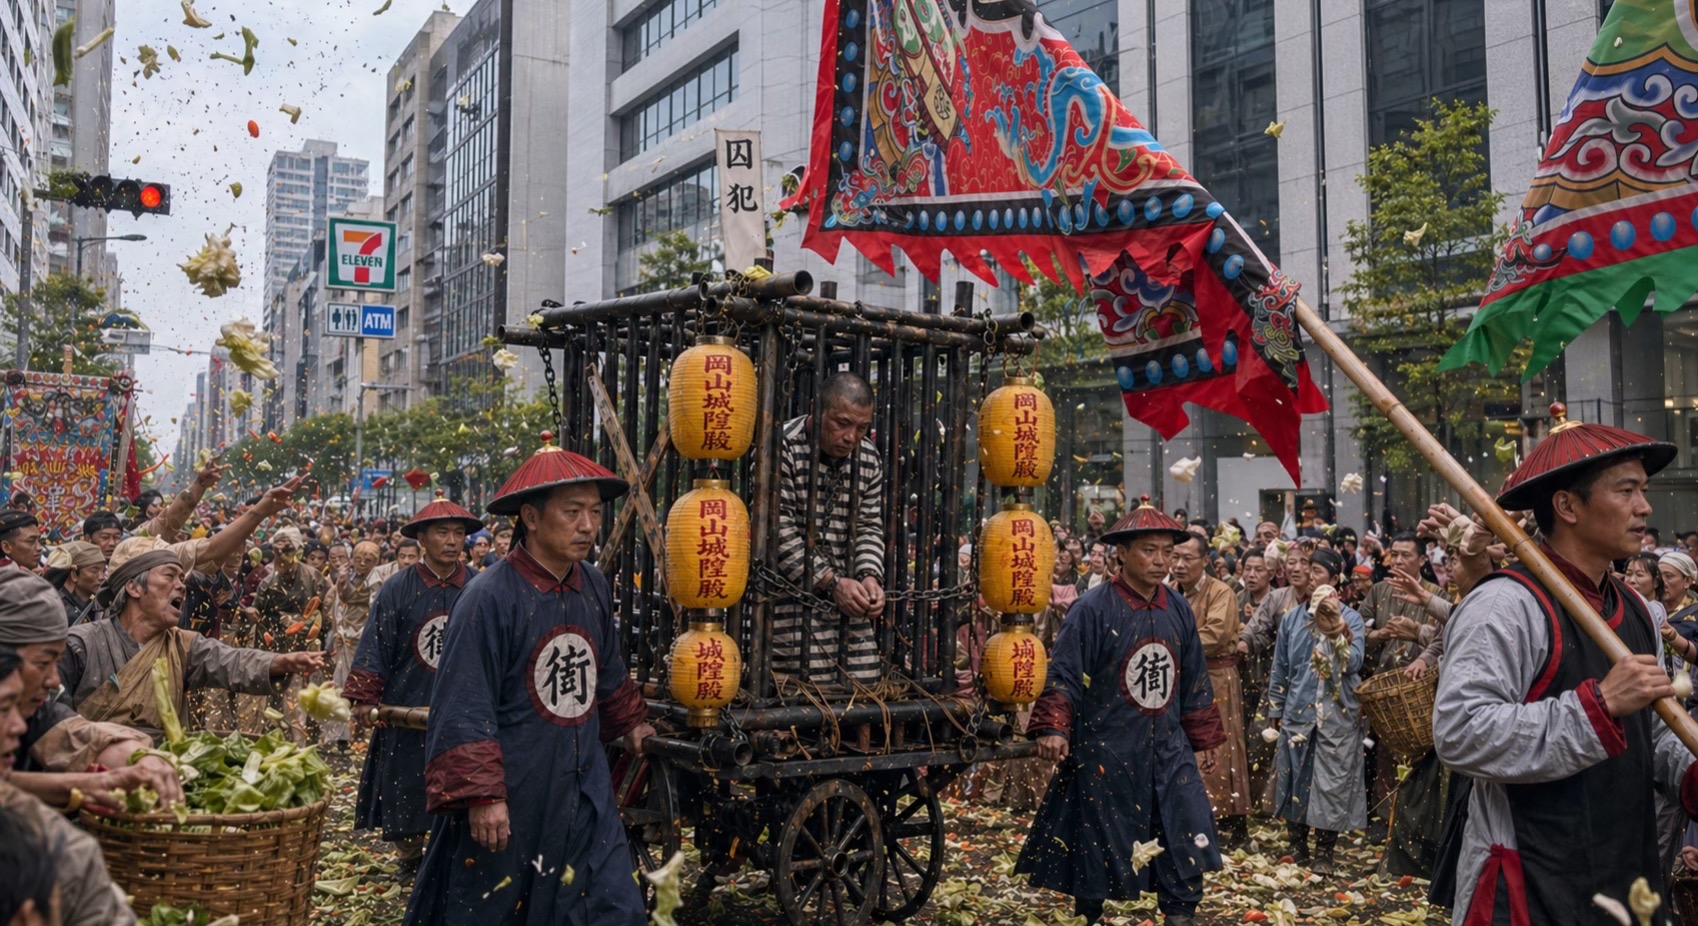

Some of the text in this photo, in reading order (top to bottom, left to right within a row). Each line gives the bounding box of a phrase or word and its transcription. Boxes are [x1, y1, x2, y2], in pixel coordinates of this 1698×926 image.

[725, 138, 759, 214] 囚犯
[341, 254, 383, 268] ELEVEN
[343, 230, 382, 283] 7
[363, 312, 392, 330] ATM
[696, 498, 730, 599] 岡山城隍殿
[1009, 518, 1038, 607] 岡山城隍殿
[694, 637, 726, 700] 城隍殿
